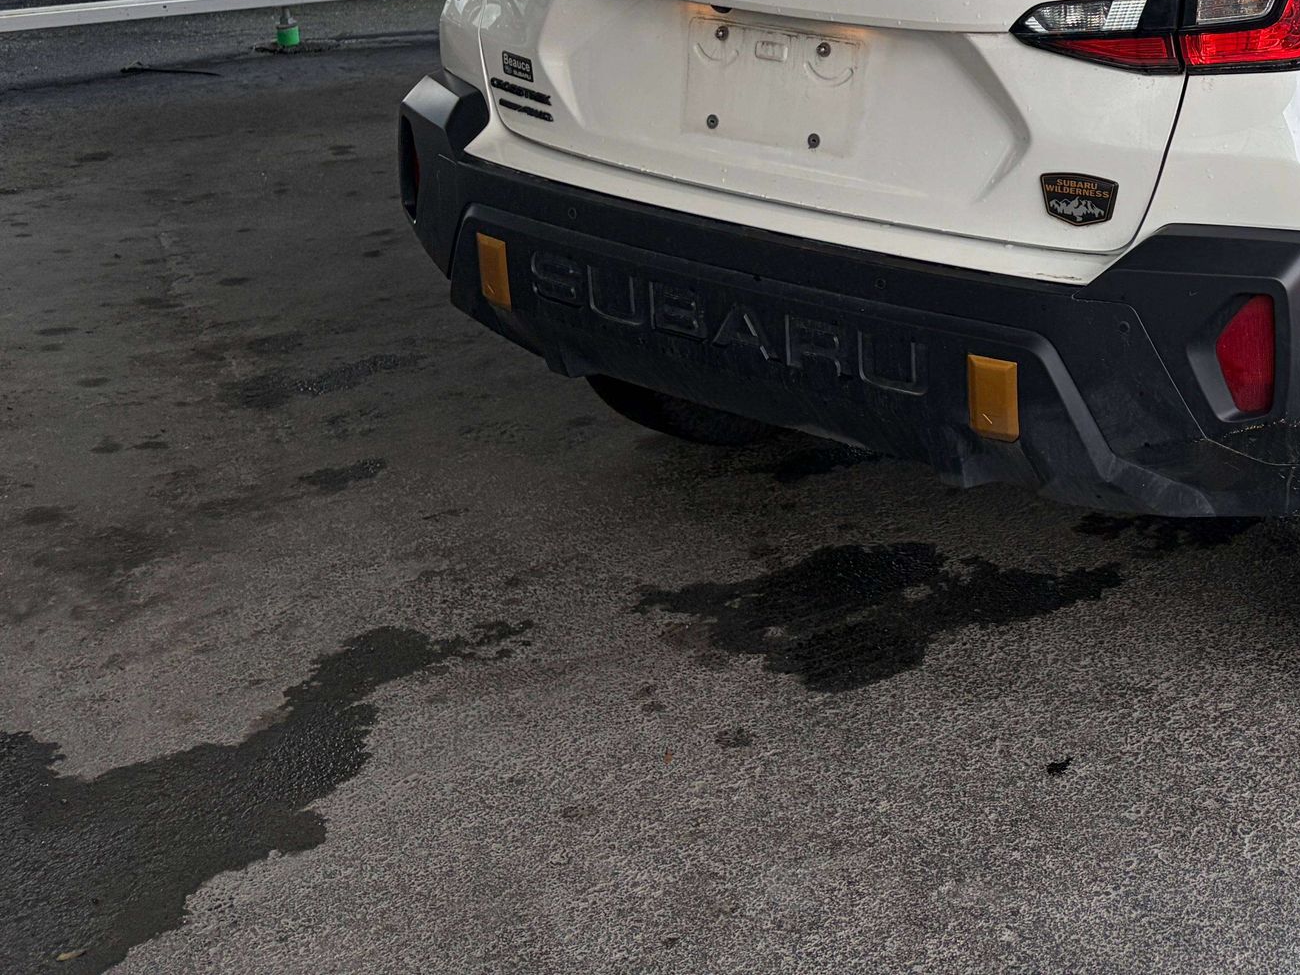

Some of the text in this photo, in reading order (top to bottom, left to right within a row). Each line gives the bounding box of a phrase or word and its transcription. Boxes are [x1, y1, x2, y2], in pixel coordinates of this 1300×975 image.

[503, 53, 531, 72] Beauce
[1045, 184, 1110, 198] WILDERNESS
[1056, 178, 1098, 190] SUBARU
[530, 249, 930, 396] SUBARU
